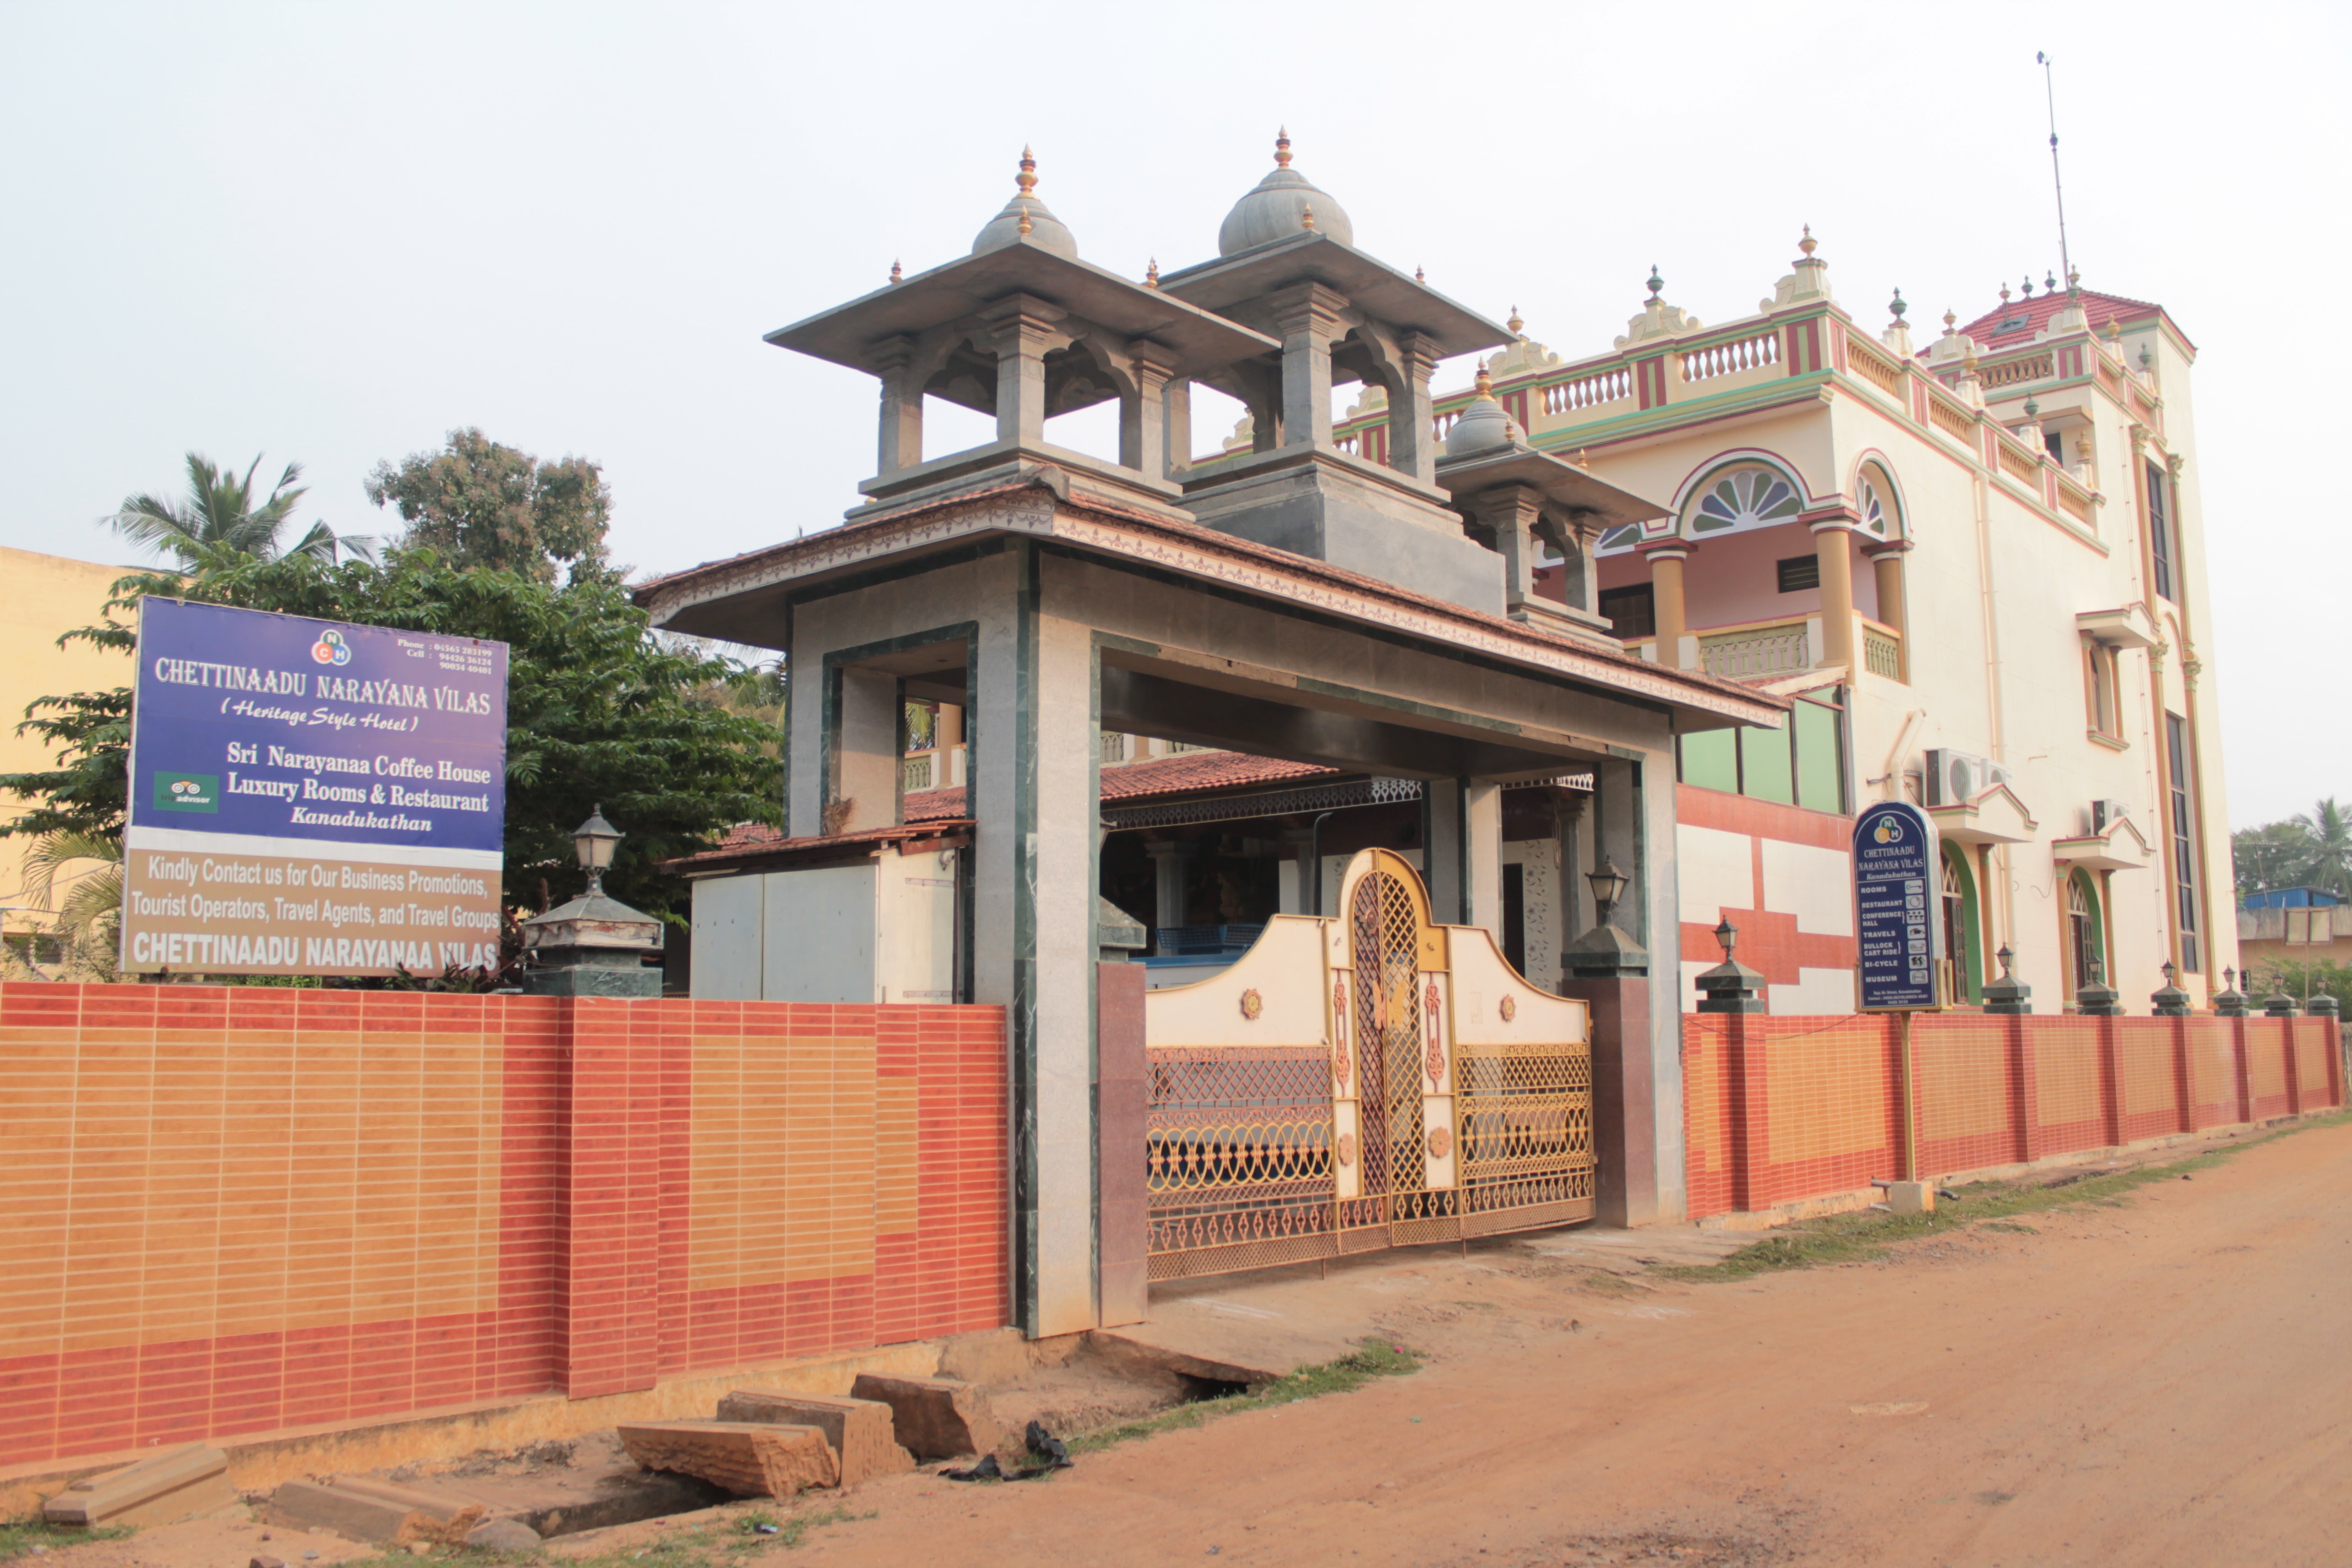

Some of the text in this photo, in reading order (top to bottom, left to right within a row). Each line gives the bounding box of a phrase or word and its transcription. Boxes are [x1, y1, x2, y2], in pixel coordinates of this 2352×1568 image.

[327, 634, 336, 644] N
[398, 639, 424, 649] Phone
[434, 644, 459, 653] 04565
[462, 647, 492, 657] 283199
[320, 648, 344, 660] C H
[407, 649, 424, 658] Cell
[439, 653, 465, 663] 94426
[467, 656, 492, 666] 36124
[439, 662, 492, 674] 90034 40401
[155, 657, 492, 715] CHETTINAADU NARAYANA VILAS
[307, 708, 356, 731] Style
[227, 742, 491, 783] Sri Narayanaa Coffee House
[227, 772, 489, 812] Luxury Rooms & Restaurant
[290, 807, 432, 831] Kanadukathan
[1864, 846, 1915, 858] CHETTINAADU
[1858, 859, 1923, 871] NARAYANA VILAS
[149, 855, 488, 899] Kindly Contact us for Our Business Promotions,
[1866, 871, 1916, 880] Kanadukathan
[132, 891, 499, 933] Tourist Operators, Travel Agents, and Travel Groups
[134, 932, 496, 971] CHETTINAADU NARAYANAA VILAS
